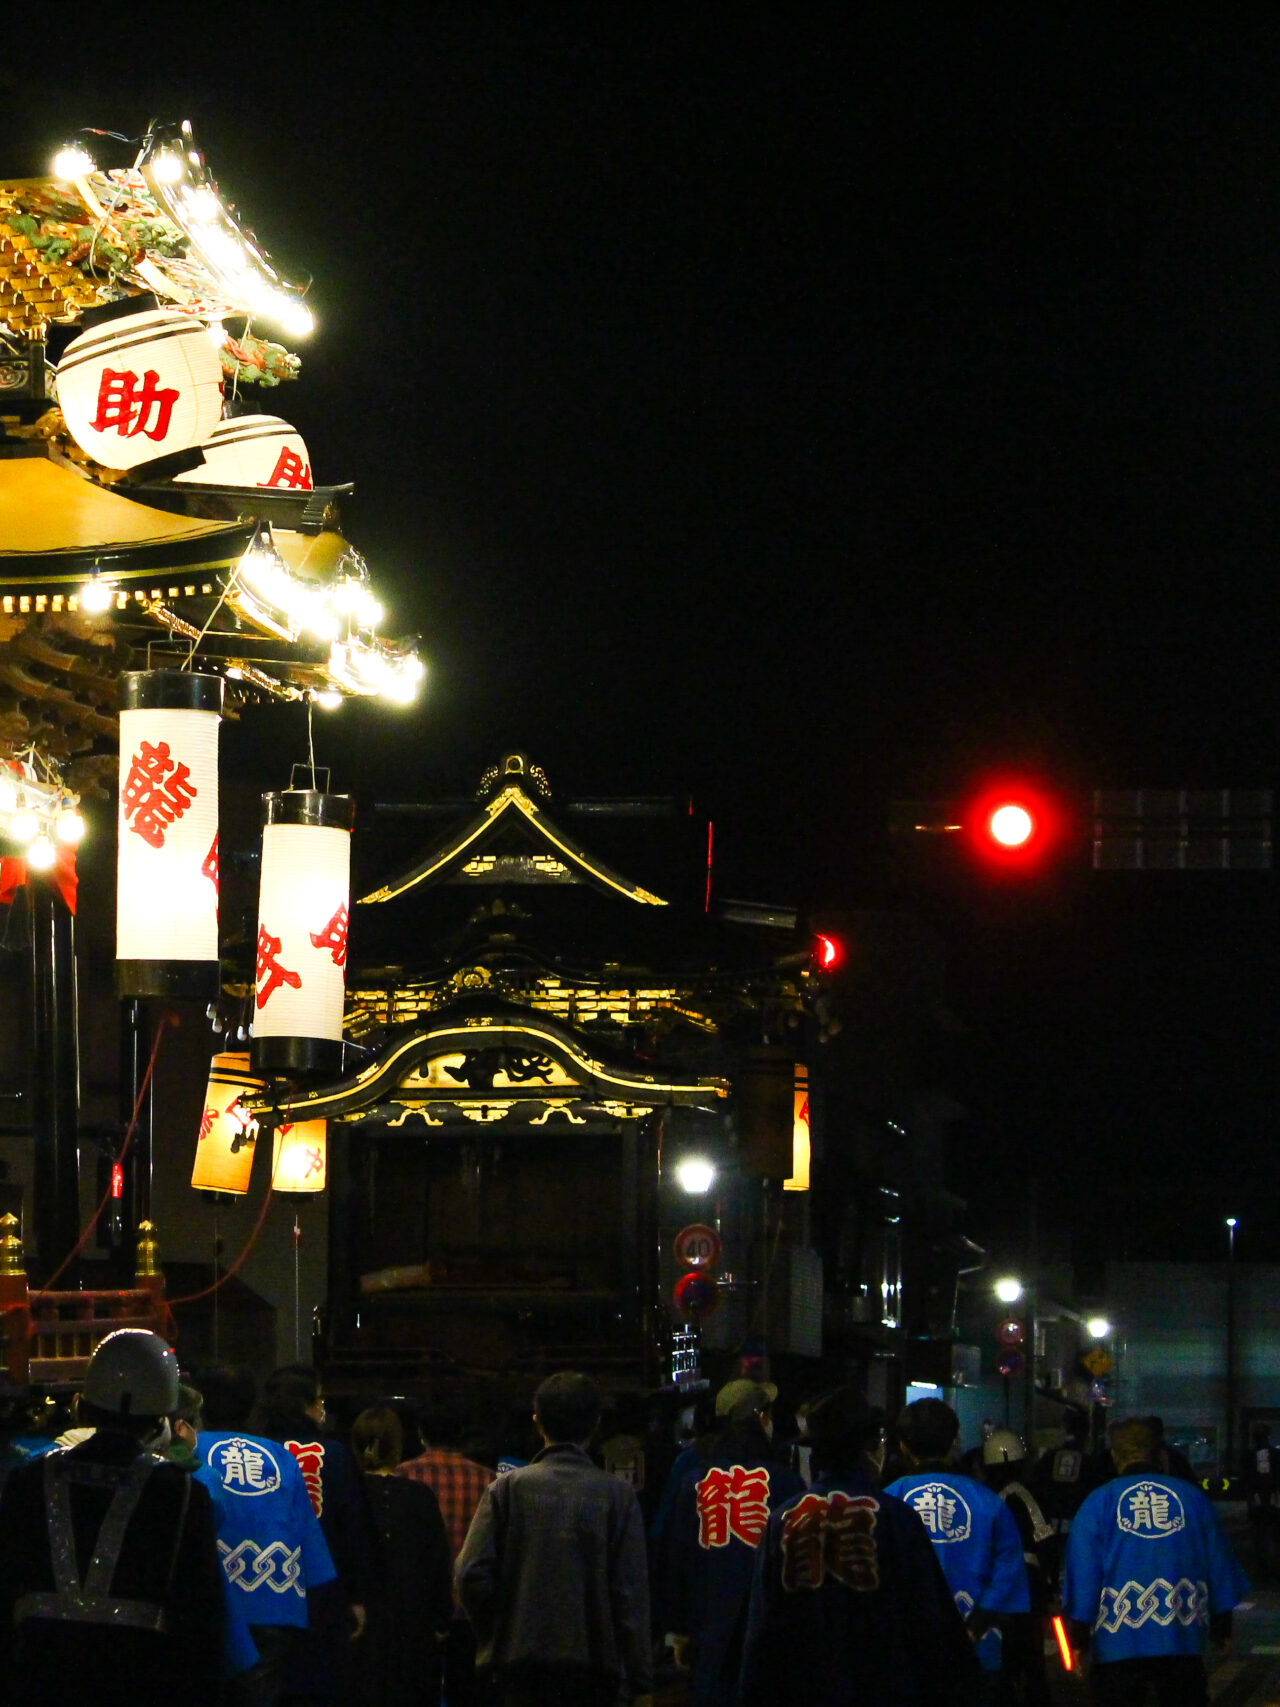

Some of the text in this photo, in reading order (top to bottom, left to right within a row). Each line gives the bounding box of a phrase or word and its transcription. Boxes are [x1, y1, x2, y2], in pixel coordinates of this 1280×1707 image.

[89, 367, 180, 442] 助
[121, 739, 198, 849] 龍
[686, 1239, 710, 1258] 40
[220, 1446, 266, 1489] 龍
[694, 1464, 770, 1550] 龍
[913, 1492, 957, 1538] 龍
[1128, 1490, 1172, 1531] 龍
